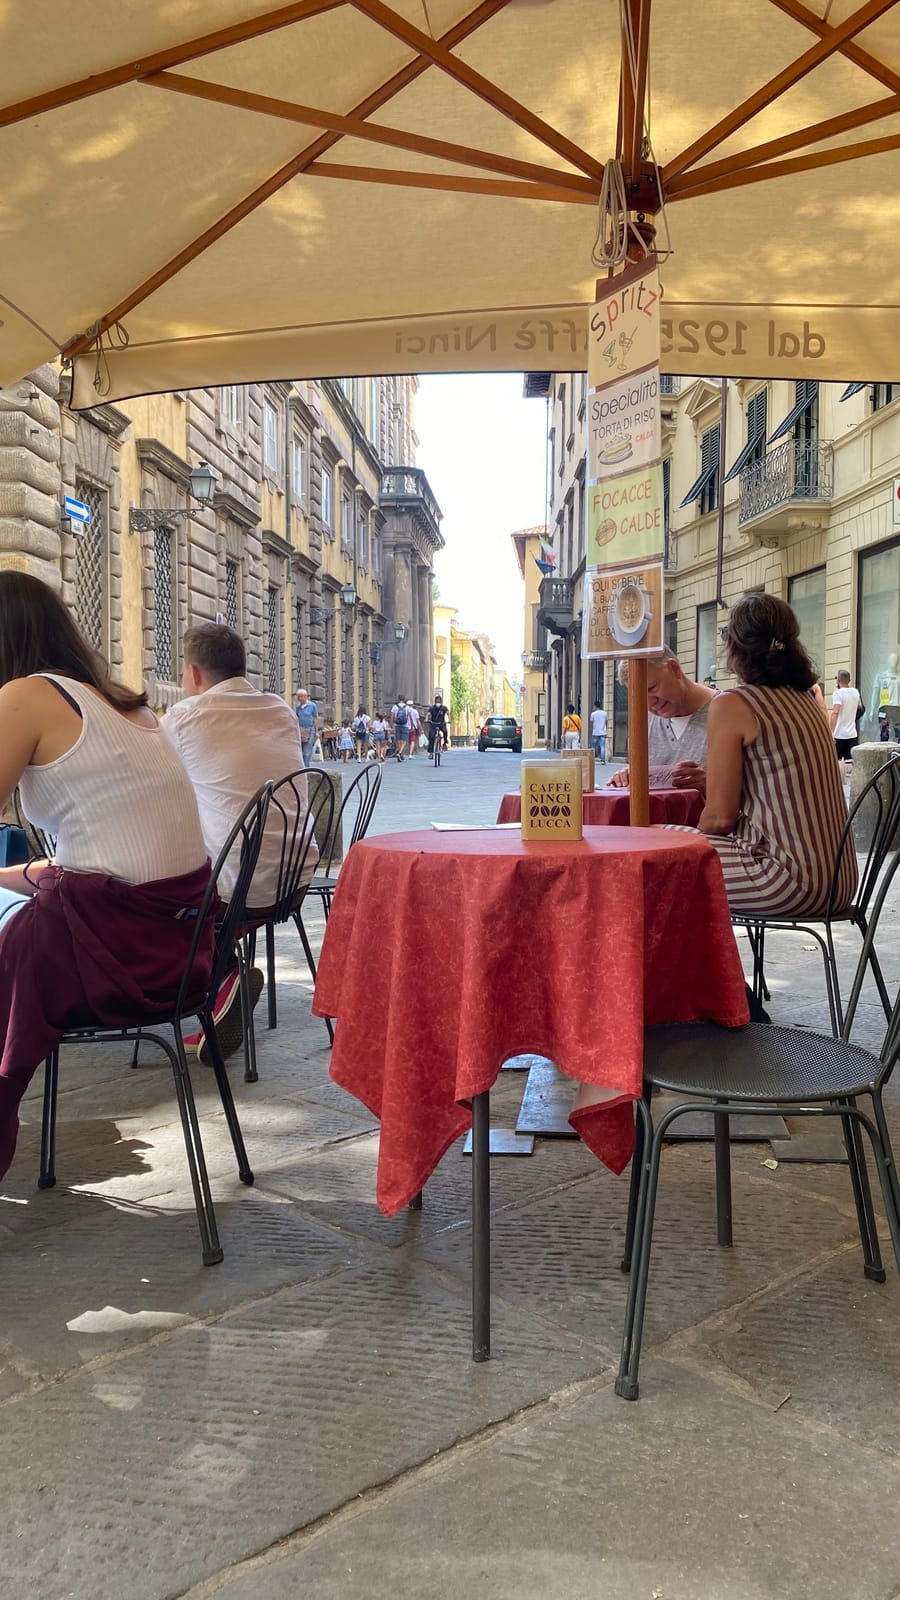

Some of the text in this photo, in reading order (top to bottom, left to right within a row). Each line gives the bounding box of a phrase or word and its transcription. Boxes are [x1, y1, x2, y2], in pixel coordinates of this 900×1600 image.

[591, 280, 658, 342] Spritz
[591, 375, 658, 423] Specialità
[593, 407, 656, 441] TORTA DI RISO
[593, 479, 653, 514] FOCACCE
[620, 508, 661, 536] CALDE
[592, 575, 644, 593] QUI SI BEVE
[529, 781, 572, 793] CAFFÈ
[530, 793, 571, 803] NINCI
[530, 819, 572, 829] LUCCA
